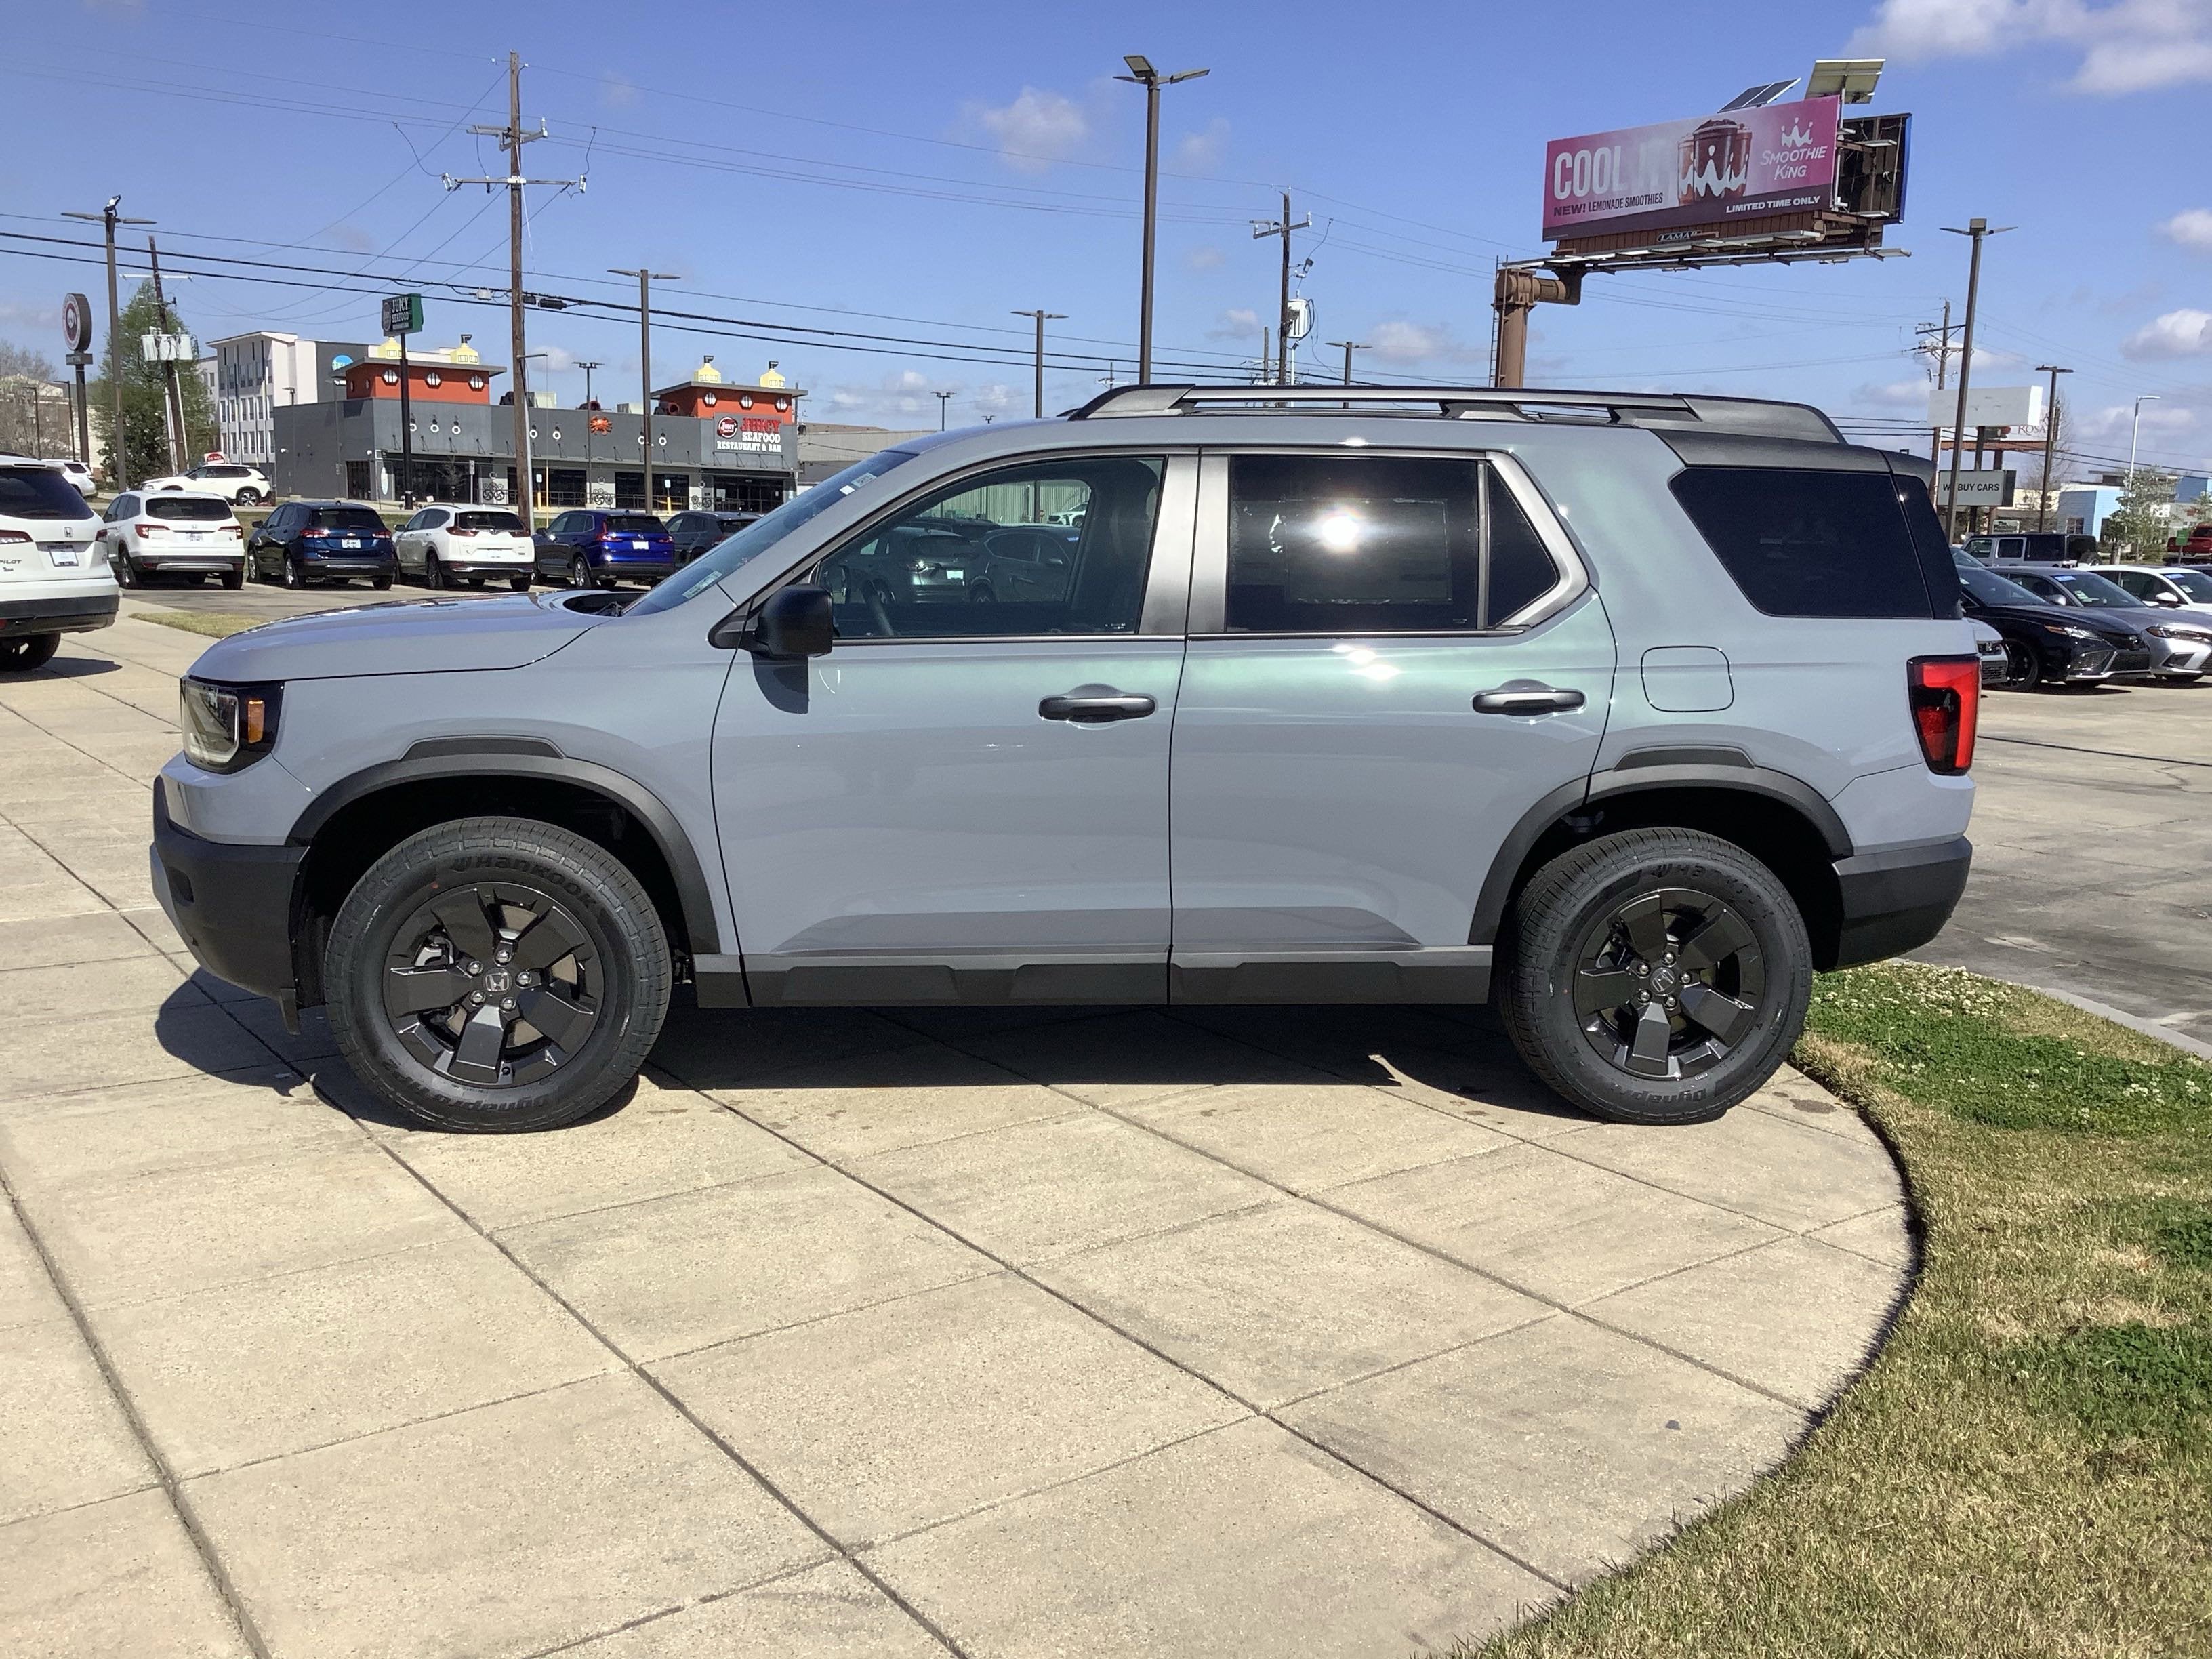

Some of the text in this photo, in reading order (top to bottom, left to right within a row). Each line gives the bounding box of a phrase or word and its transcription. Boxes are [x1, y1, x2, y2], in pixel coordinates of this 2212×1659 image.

[1761, 146, 1828, 165] SMOOTHIE
[1554, 146, 1627, 200] COOL
[1553, 193, 1663, 217] NEW! LEMONADE SMOOTHIES
[1726, 195, 1820, 213] LIMITED TIME ONLY
[392, 297, 408, 313] JUICY
[392, 311, 409, 323] SEAFOOD
[740, 418, 781, 434] JUICY
[2018, 425, 2046, 436] ROSA
[742, 432, 781, 443] SEAFOOD
[717, 441, 781, 453] RESTAURANT & BAR
[1958, 483, 1975, 491] BUY
[1977, 483, 1999, 491] CARS
